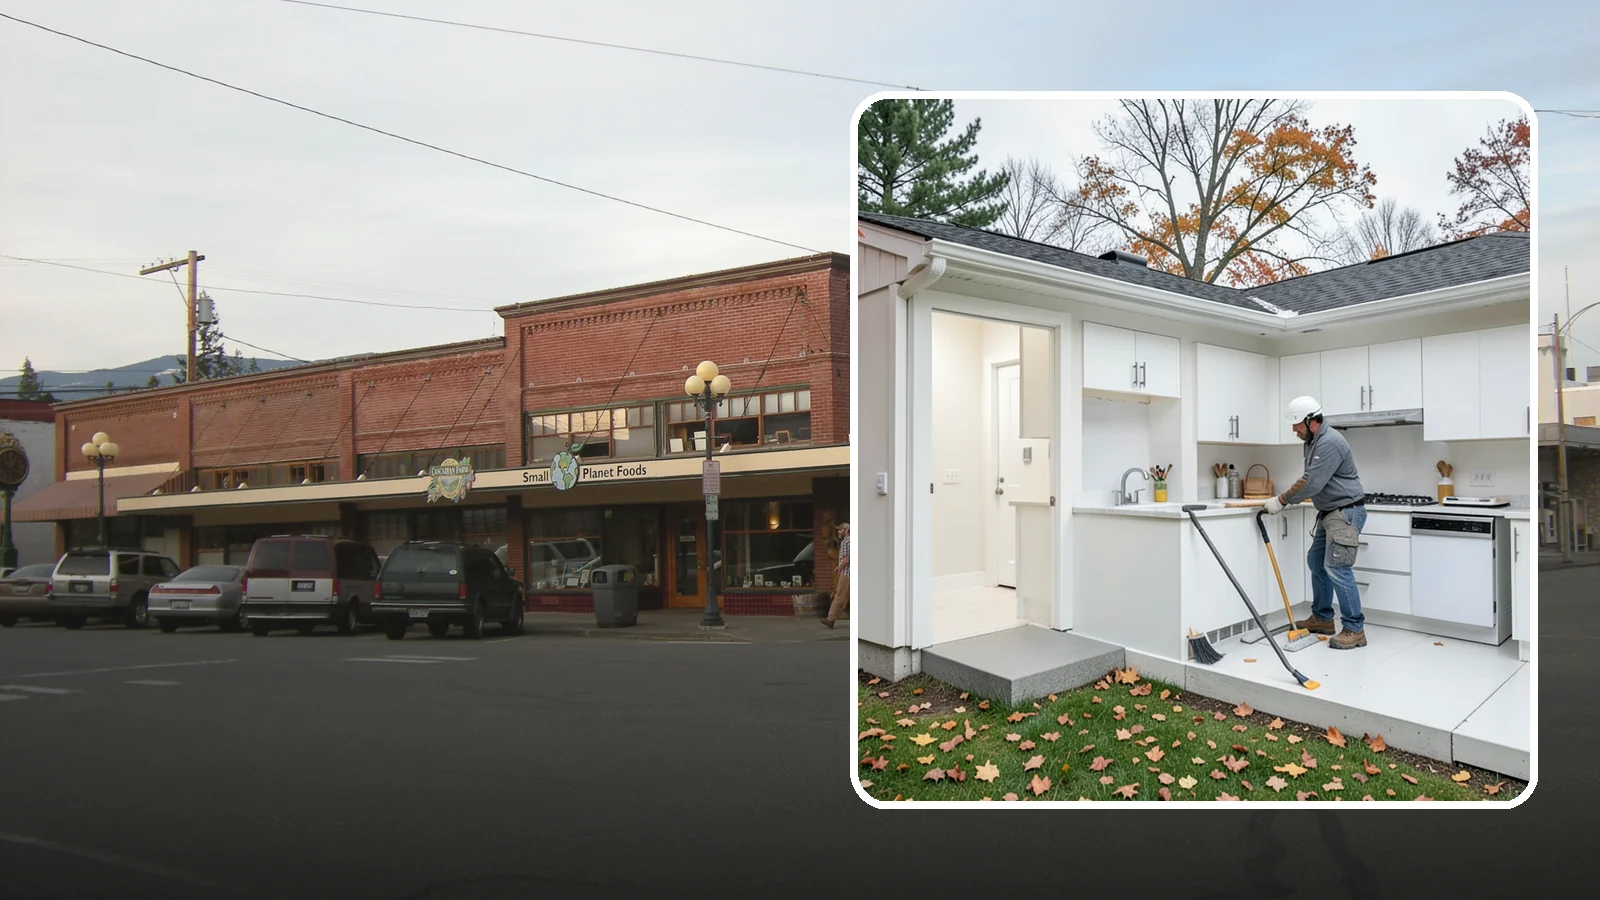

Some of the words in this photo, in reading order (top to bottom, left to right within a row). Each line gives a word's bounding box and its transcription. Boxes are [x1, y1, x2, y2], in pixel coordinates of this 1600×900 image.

[522, 471, 549, 483] Small
[582, 467, 614, 479] Planet
[616, 464, 647, 477] Foods
